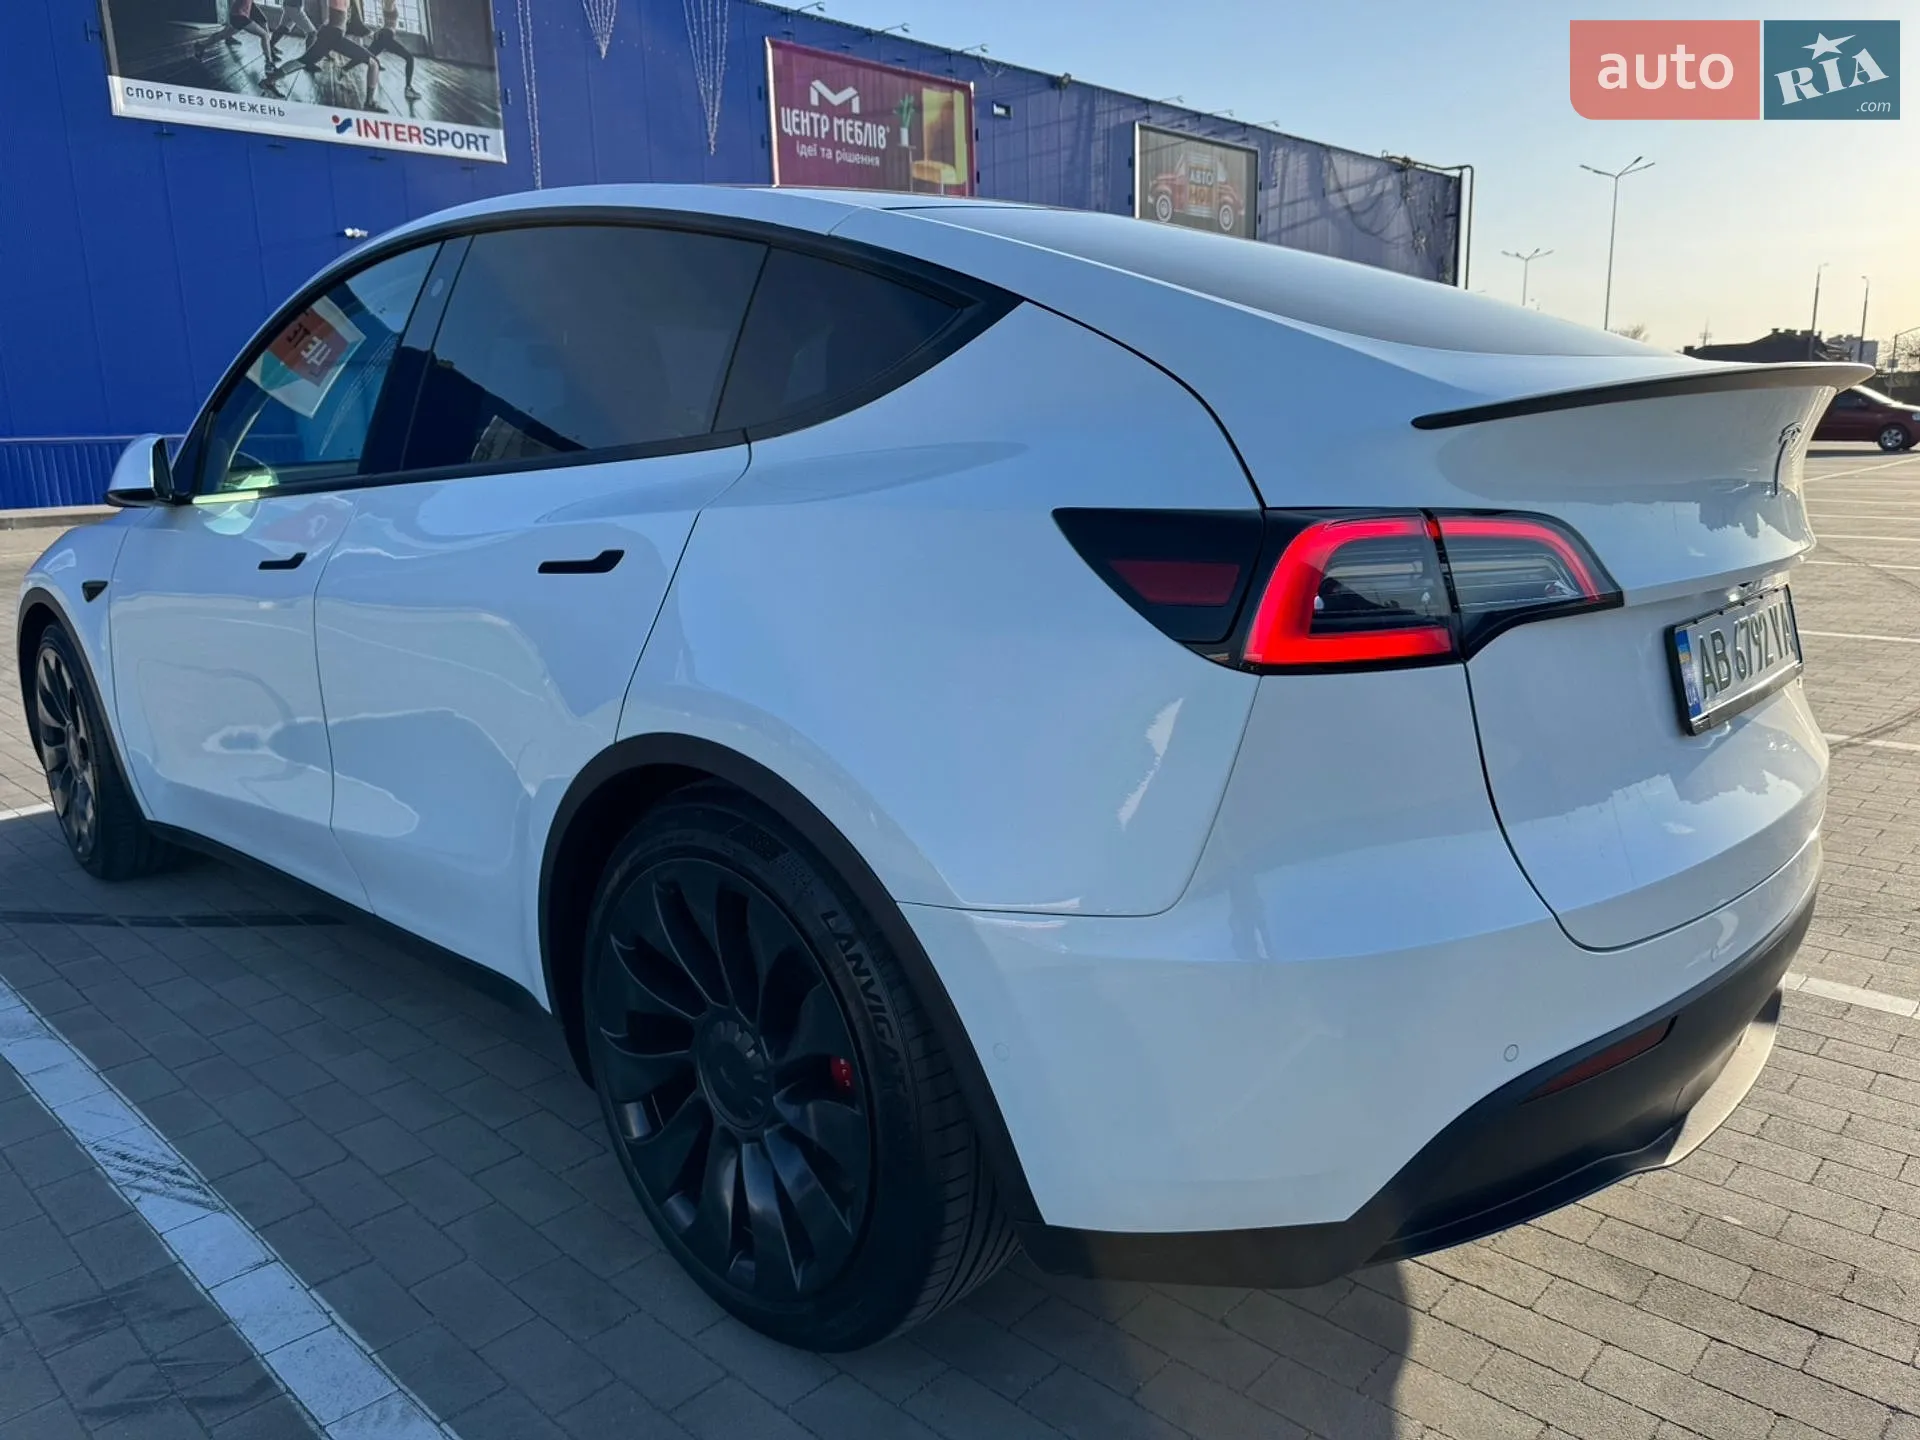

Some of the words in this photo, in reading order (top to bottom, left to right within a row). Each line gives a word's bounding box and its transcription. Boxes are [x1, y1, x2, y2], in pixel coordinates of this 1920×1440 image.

[126, 86, 172, 103] СПОРТ
[178, 93, 205, 107] БЕЗ
[210, 97, 286, 118] ОБМЕЖЕНЬ
[355, 117, 490, 153] INTERSPORT
[781, 107, 830, 139] ЦЕНТР
[819, 145, 834, 160] та
[835, 147, 881, 168] рішення
[1699, 628, 1732, 700] AB
[1734, 611, 1775, 681] 6792
